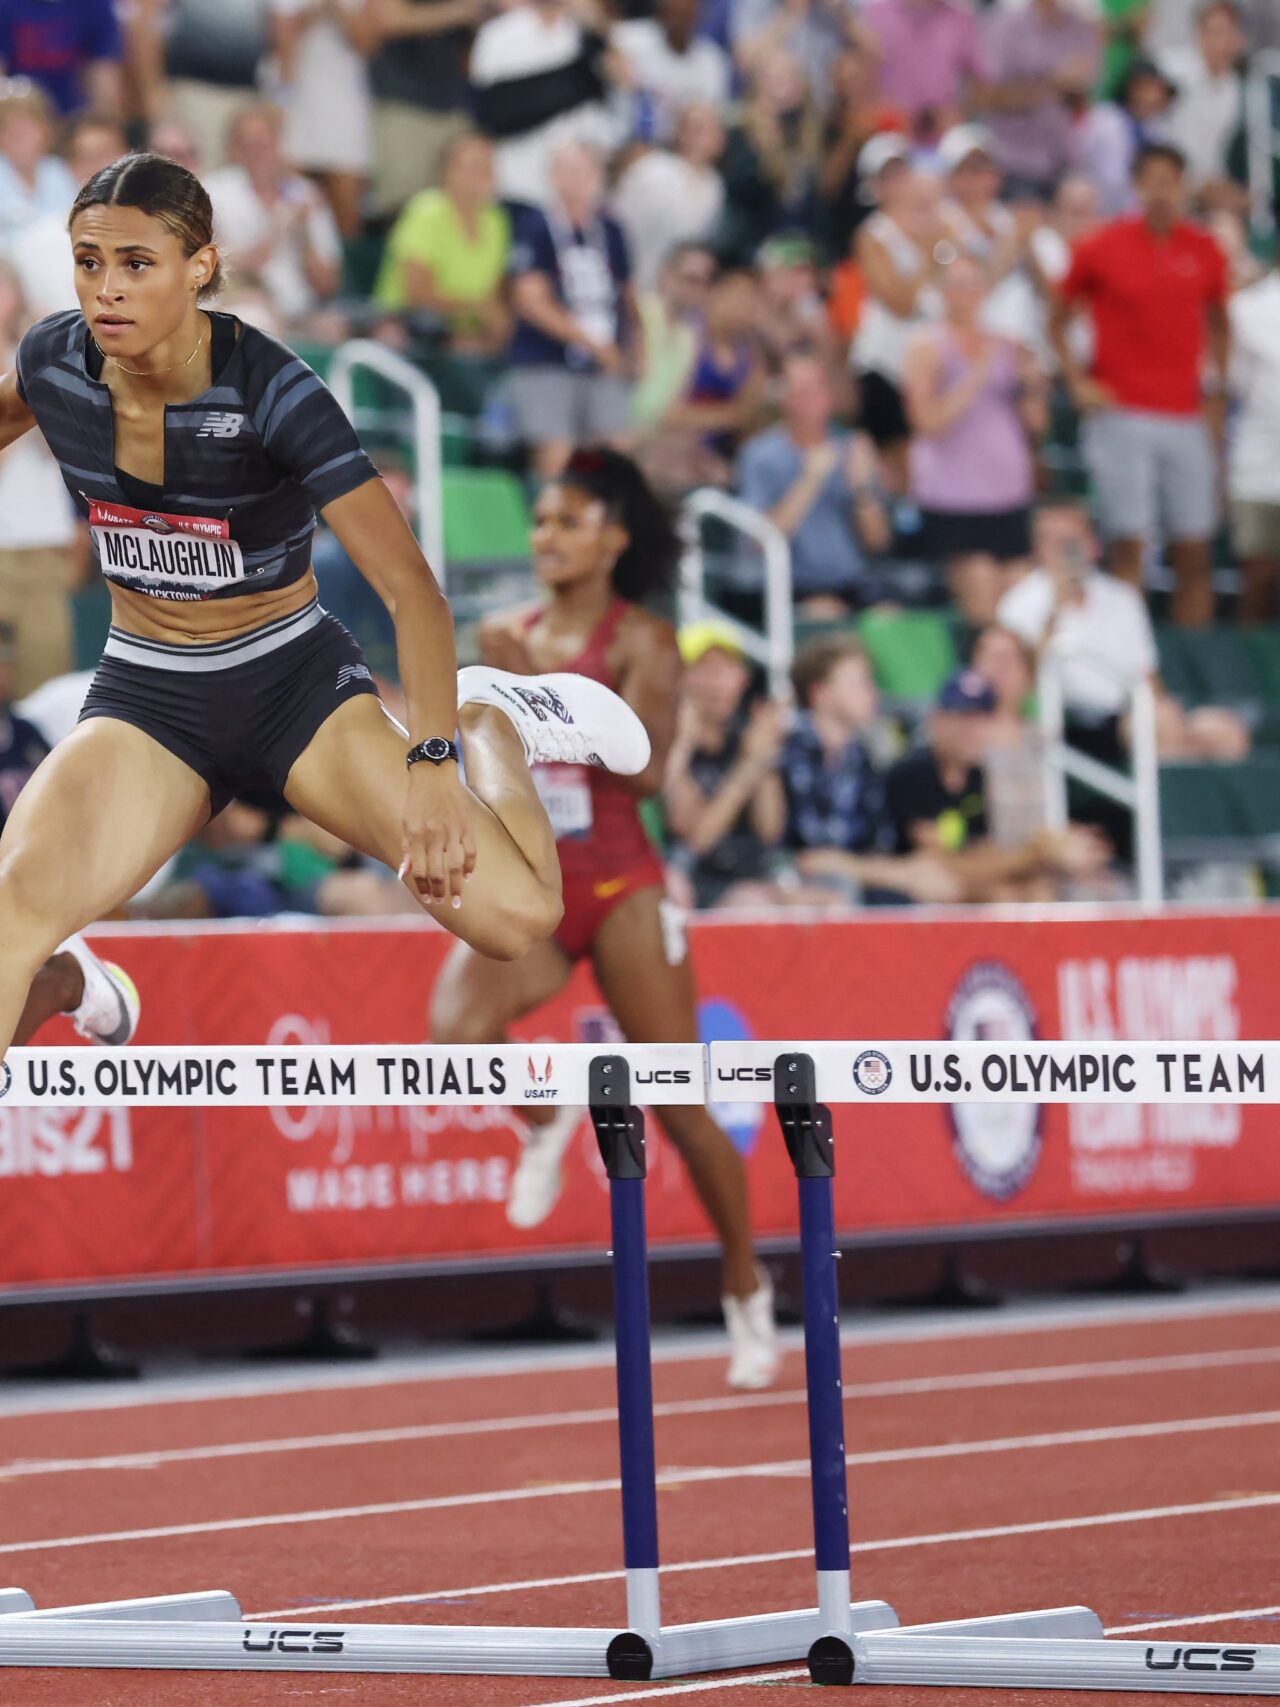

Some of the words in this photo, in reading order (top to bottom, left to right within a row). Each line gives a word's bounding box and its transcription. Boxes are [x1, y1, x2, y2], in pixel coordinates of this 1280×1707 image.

[104, 531, 237, 579] MCLAUGHLIN
[28, 1059, 85, 1096] U.S.
[94, 1058, 238, 1096] OLYMPIC
[255, 1057, 356, 1095] TEAM
[376, 1056, 507, 1095] TRIALS
[635, 1070, 692, 1084] UCS
[717, 1067, 773, 1082] UCS
[909, 1053, 972, 1093] U.S.
[981, 1053, 1137, 1093] OLYMPIC
[1155, 1053, 1265, 1093] TEAM
[523, 1089, 559, 1099] USATF
[242, 1629, 346, 1654] UCS
[1145, 1647, 1257, 1672] UCS
